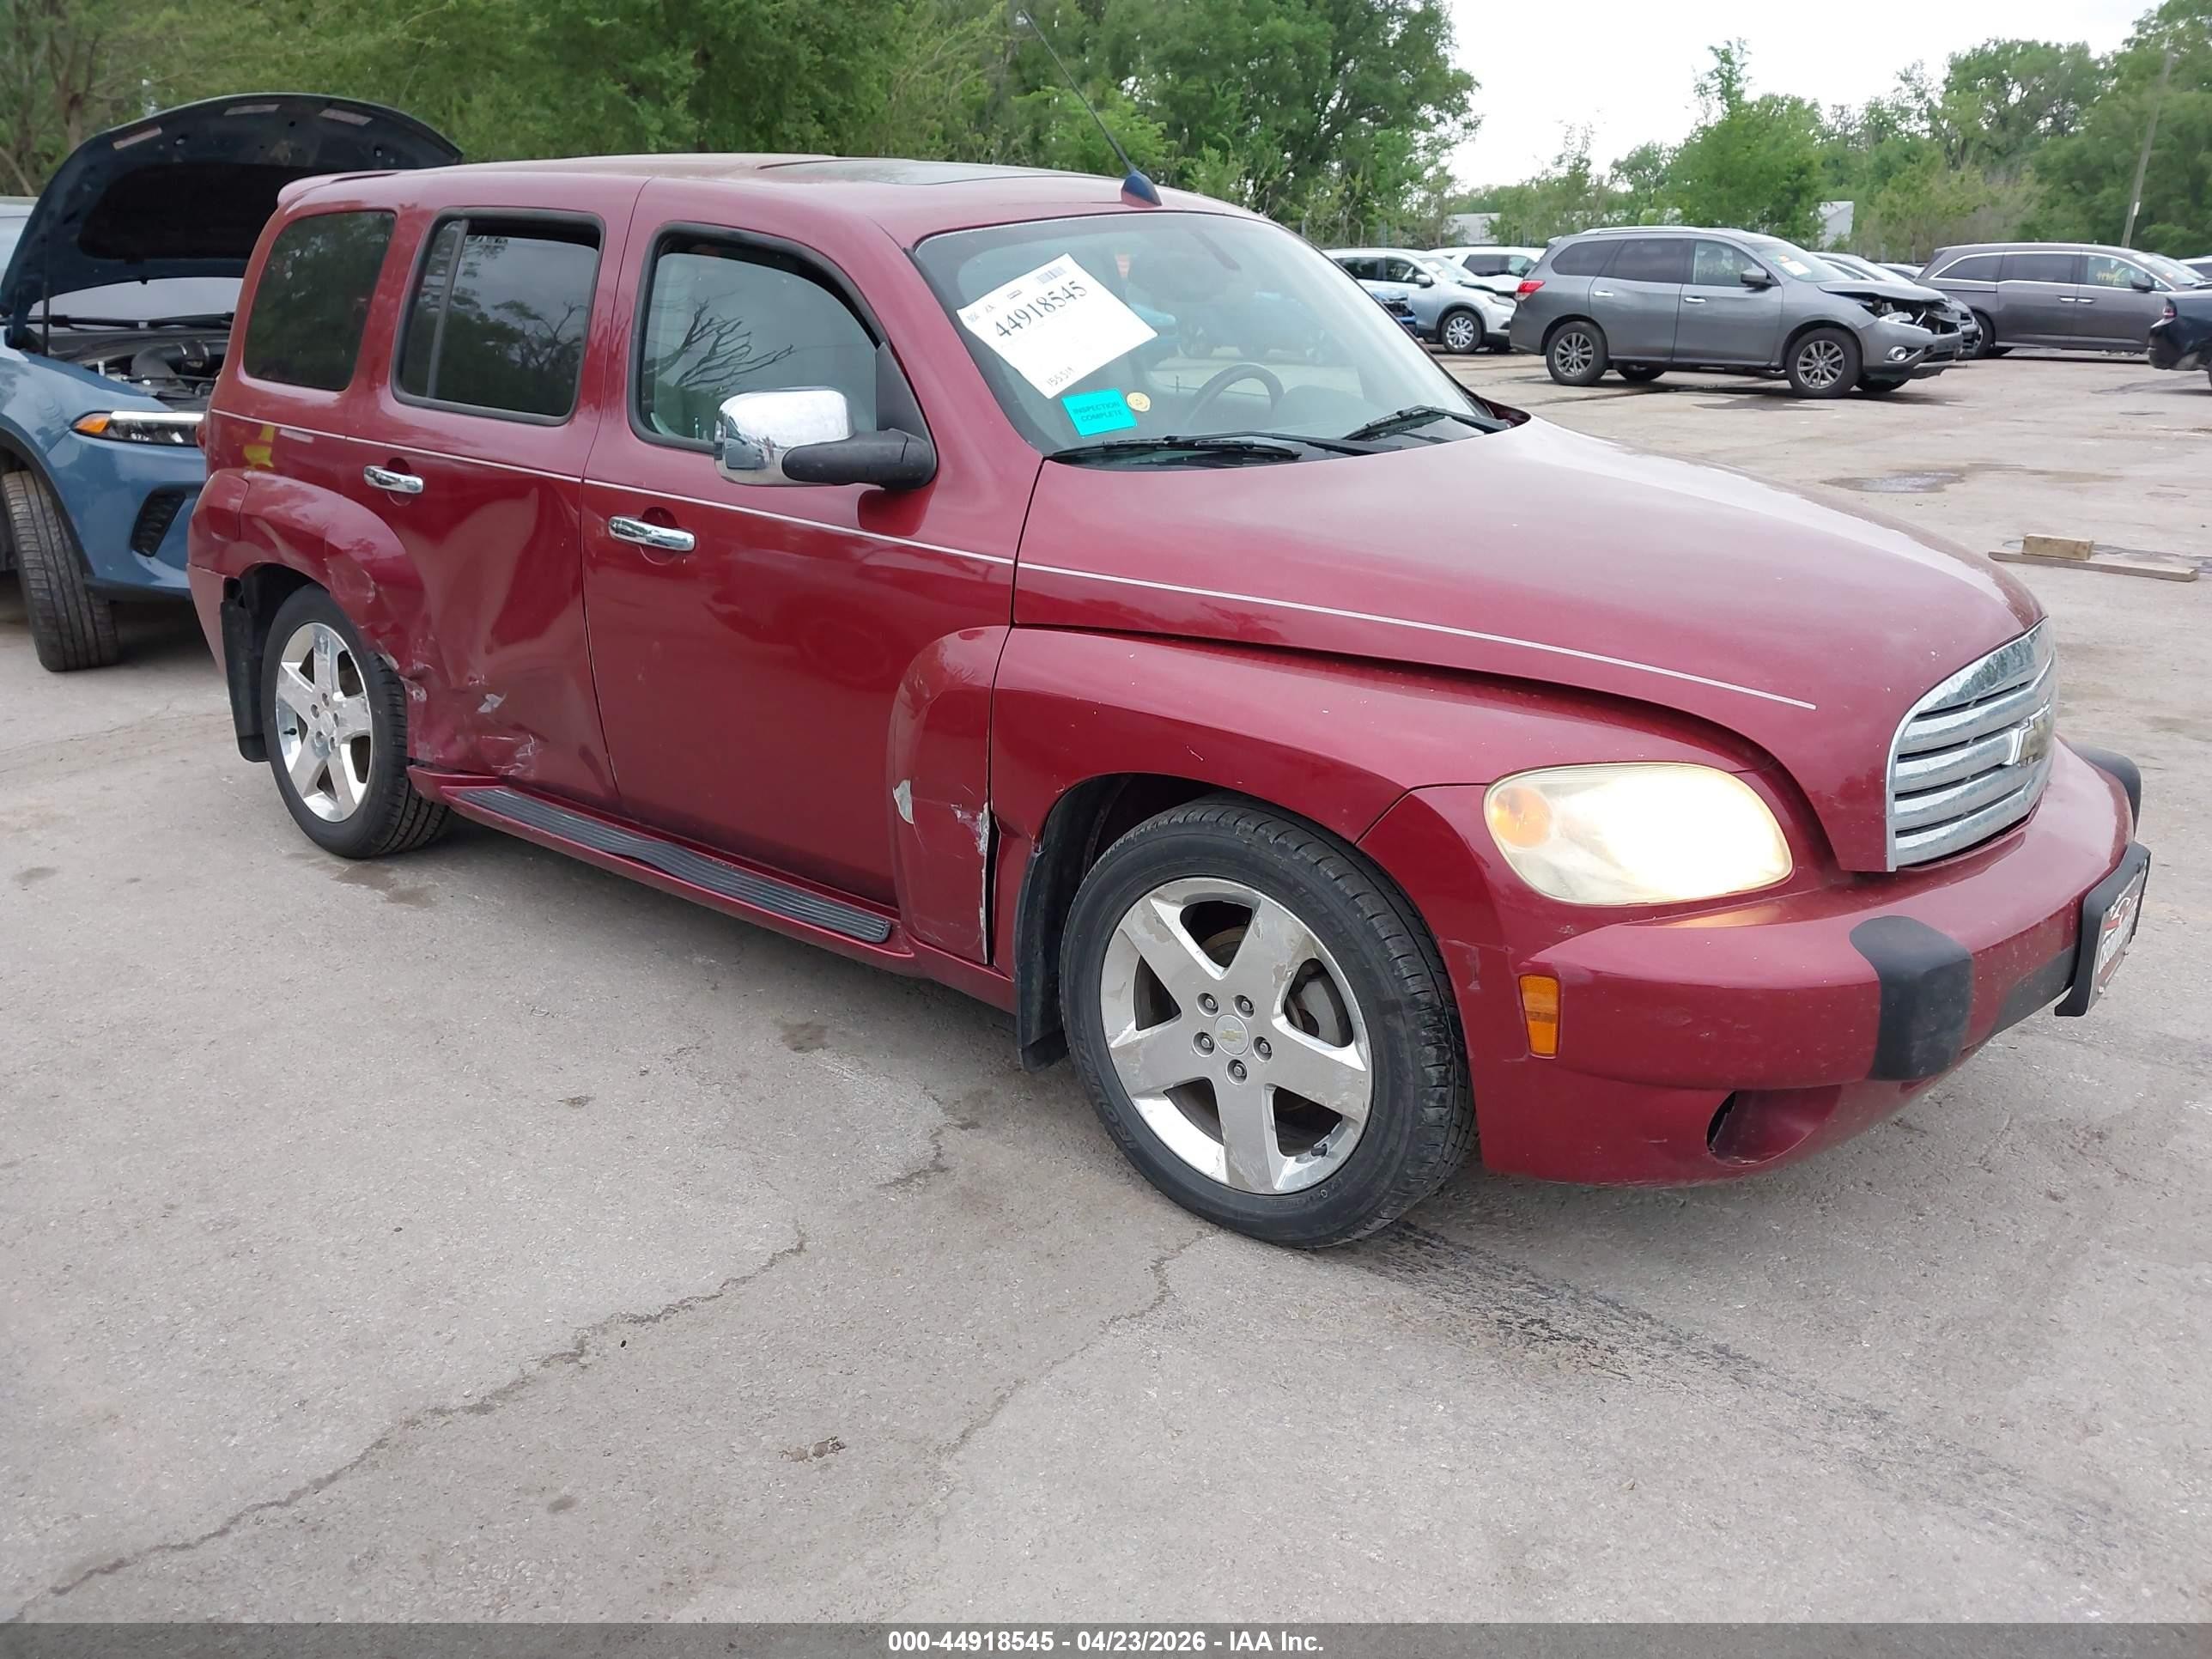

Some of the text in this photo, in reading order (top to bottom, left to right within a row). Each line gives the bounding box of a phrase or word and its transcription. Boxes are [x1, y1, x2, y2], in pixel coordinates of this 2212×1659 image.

[996, 280, 1088, 337] 44918545
[1072, 401, 1121, 414] INSPECTION
[1079, 409, 1123, 422] COMPLETE
